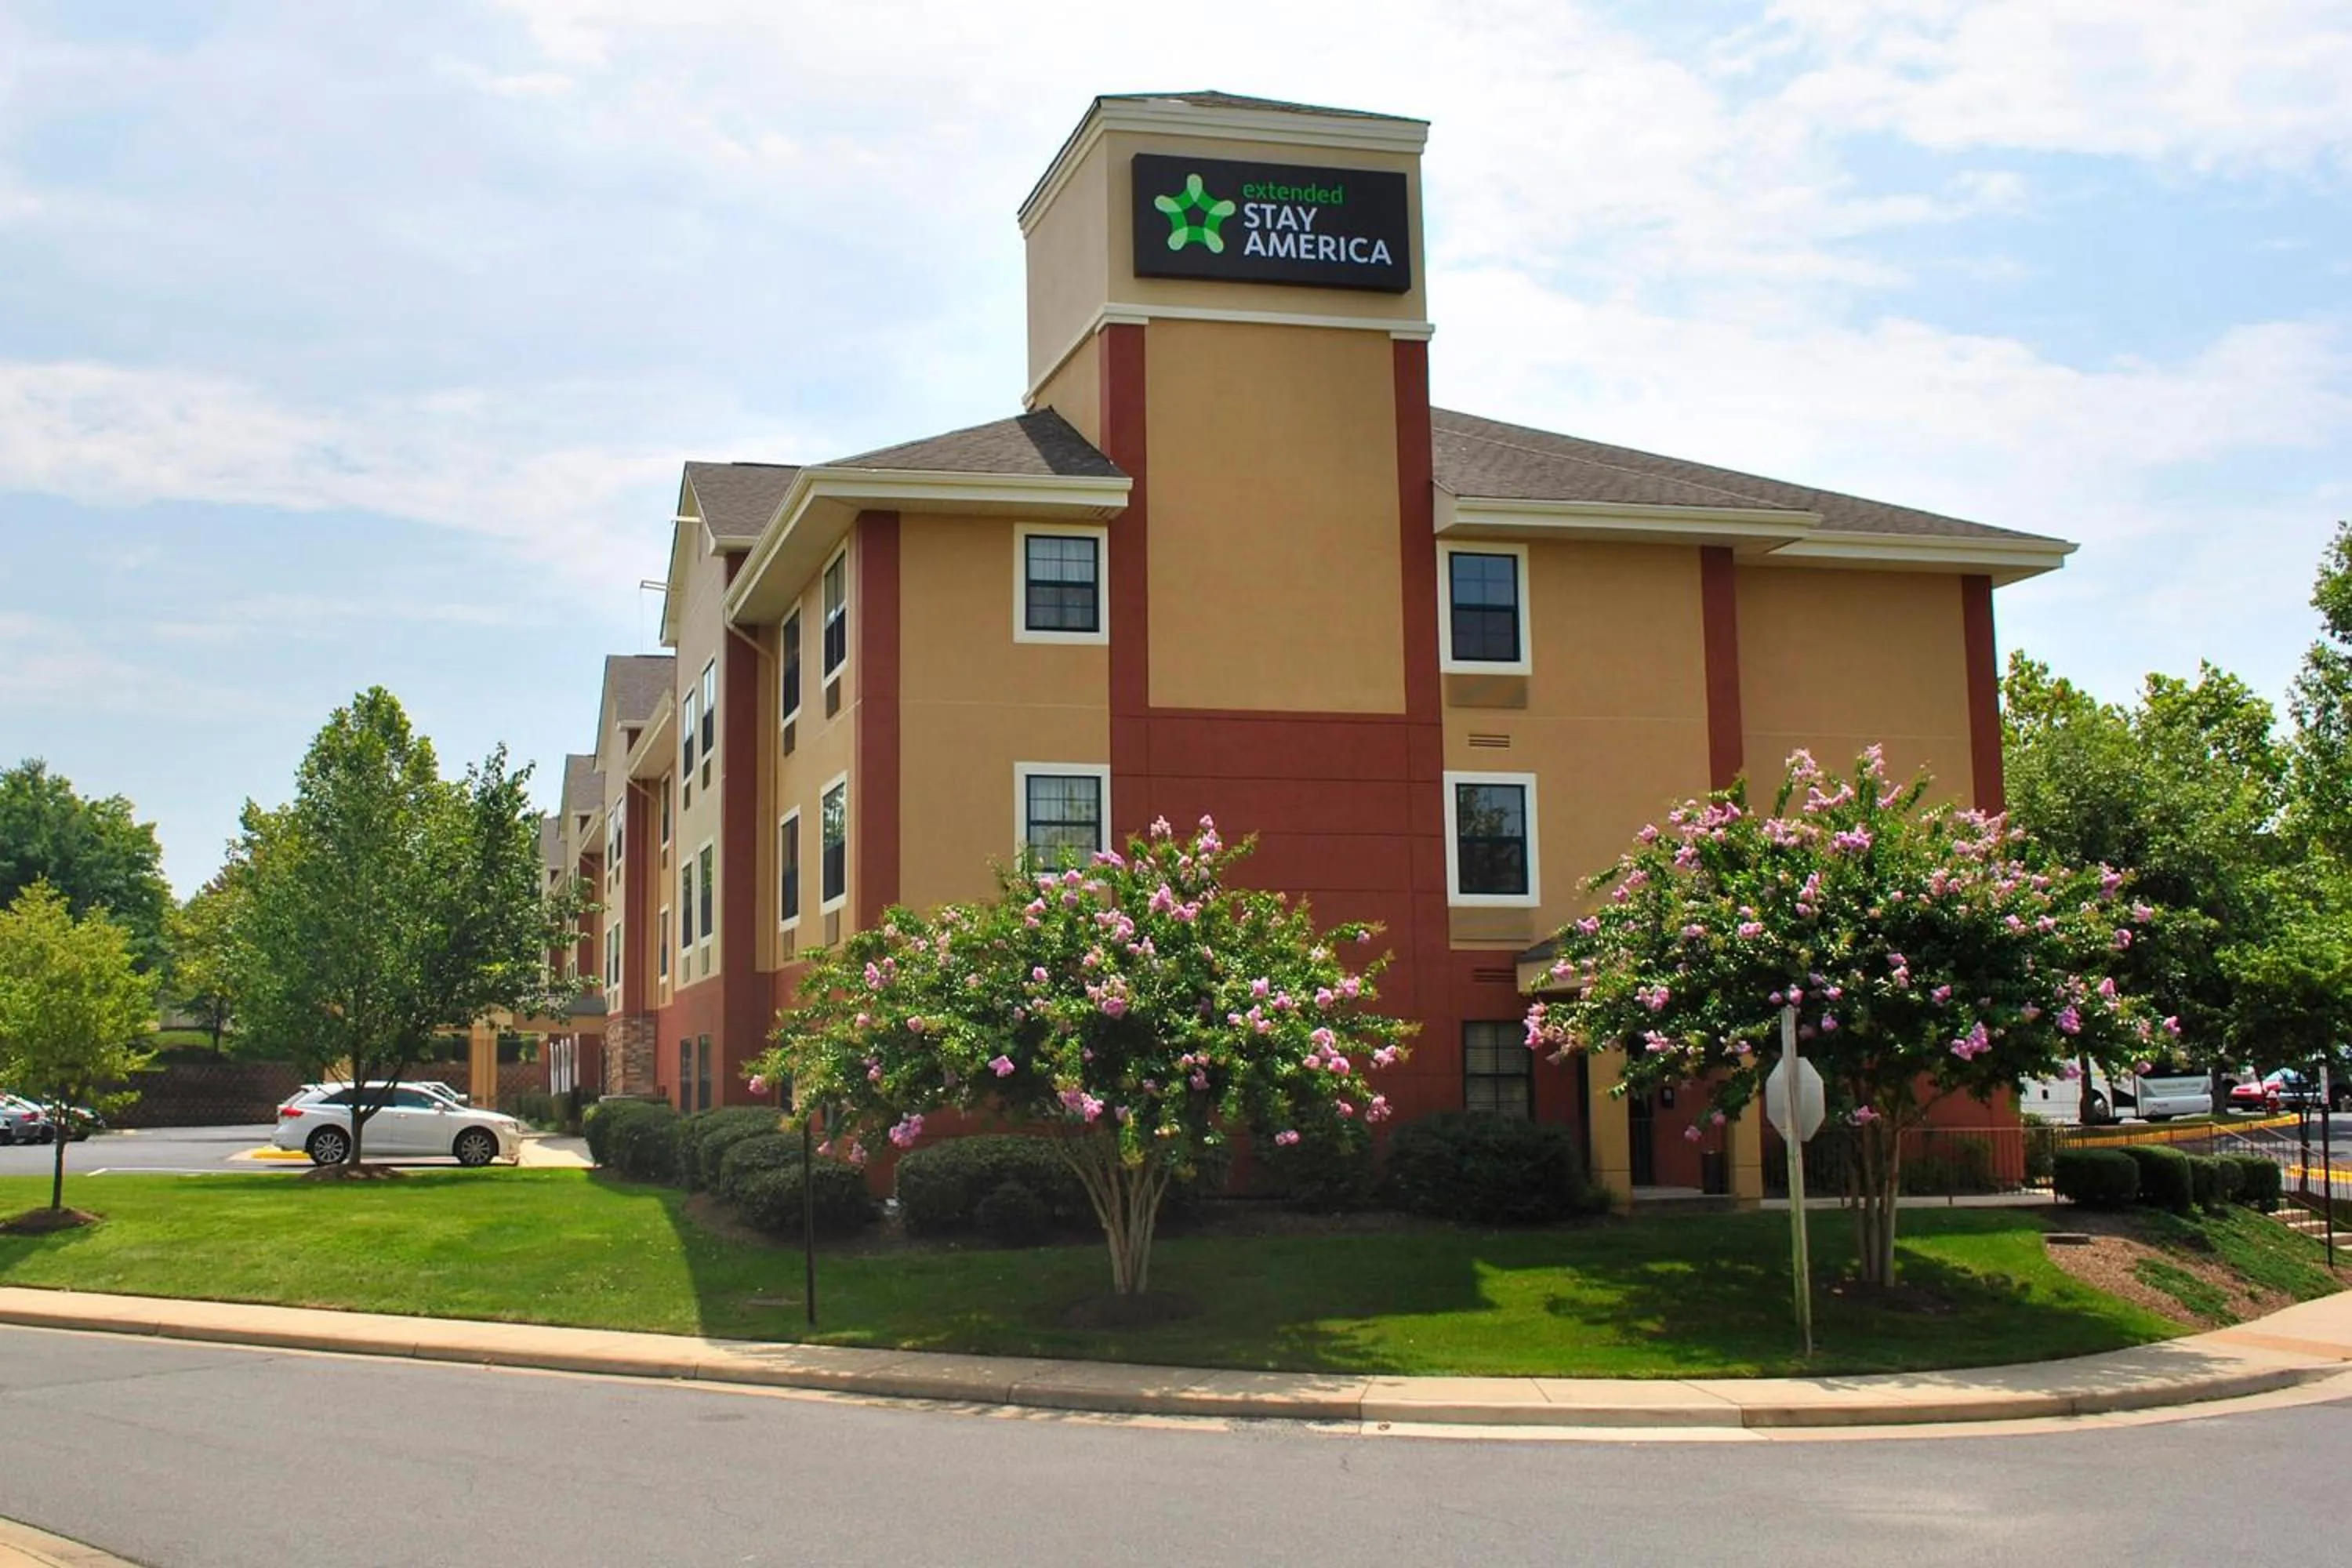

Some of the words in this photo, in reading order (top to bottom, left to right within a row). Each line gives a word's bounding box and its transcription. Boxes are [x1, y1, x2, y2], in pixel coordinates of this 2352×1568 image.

[1243, 182, 1344, 204] extended
[1243, 202, 1318, 231] STAY
[1243, 230, 1392, 265] AMERICA
